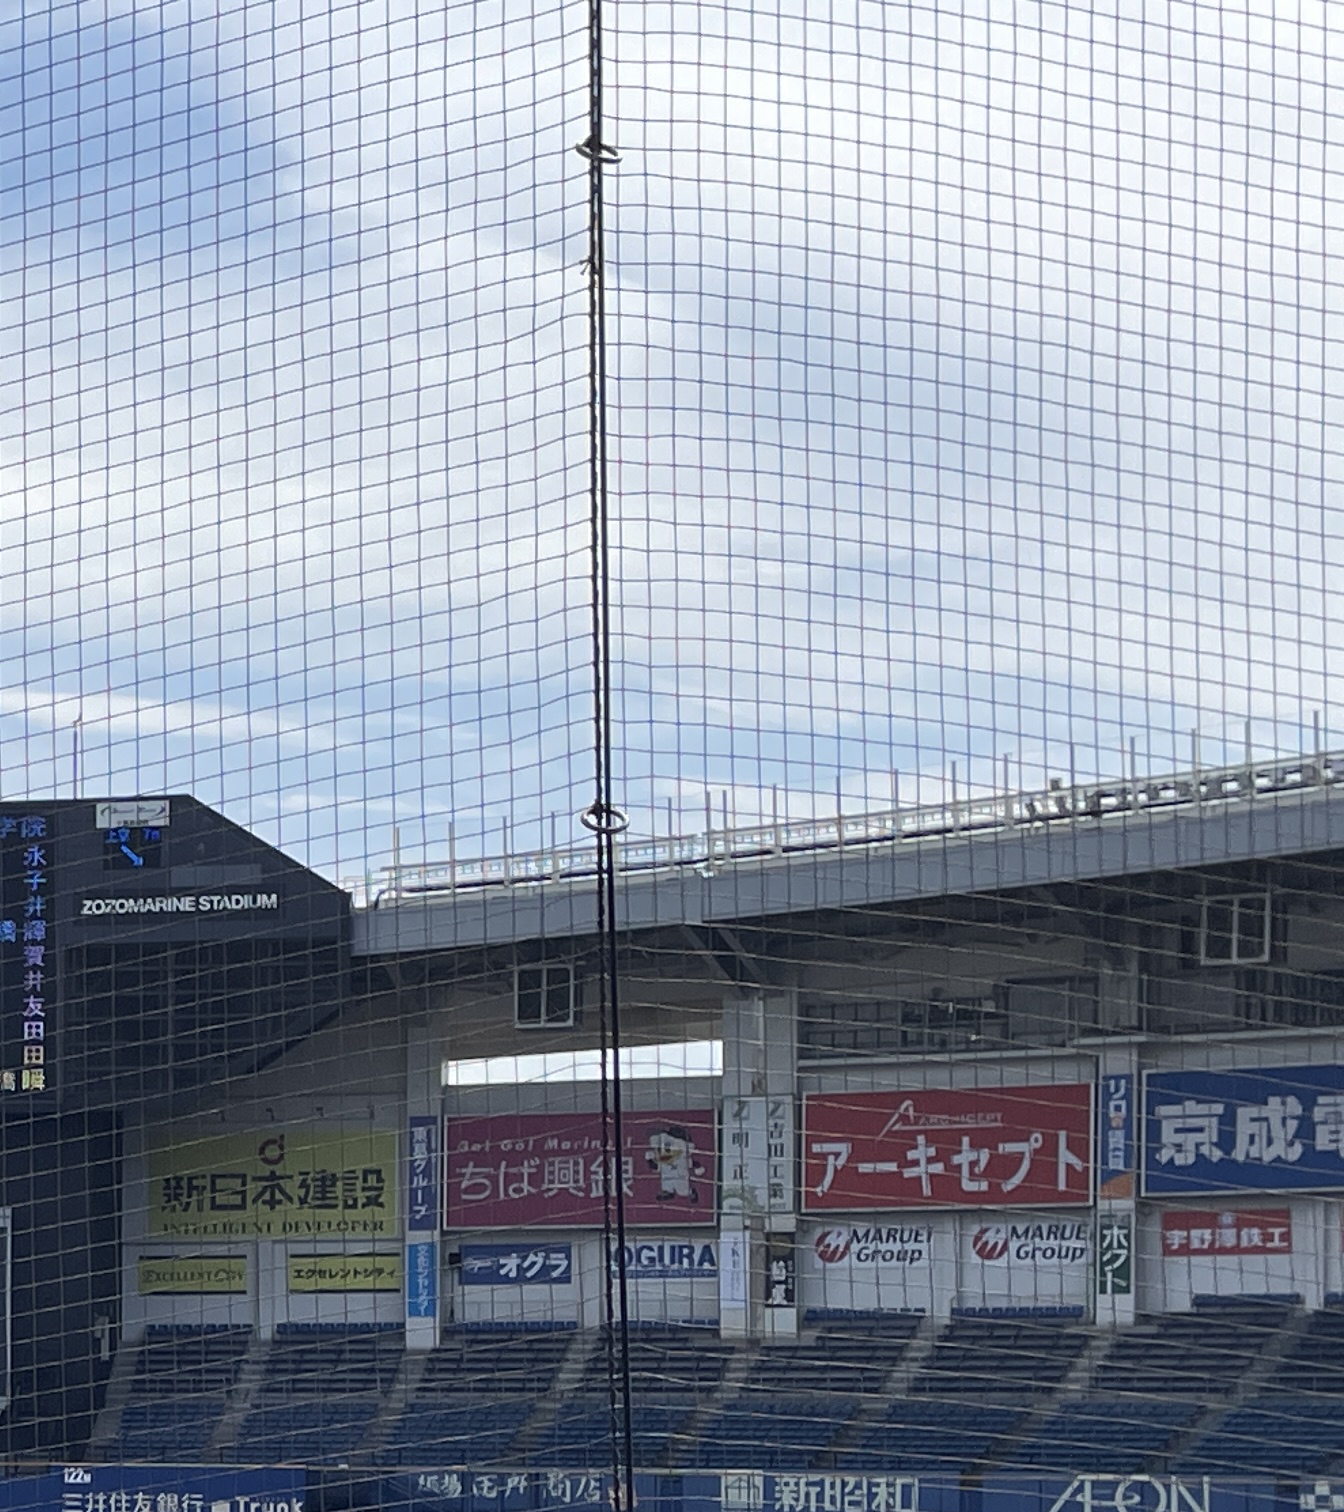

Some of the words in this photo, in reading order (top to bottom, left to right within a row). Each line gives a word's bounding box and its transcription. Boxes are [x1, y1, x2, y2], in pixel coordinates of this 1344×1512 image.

[81, 895, 196, 915] ZOZOMARINE
[199, 893, 278, 912] STADIUM
[812, 1130, 1083, 1197] アーキセプト
[162, 1168, 386, 1213] 新日本建設
[456, 1156, 634, 1200] ちば興銀
[850, 1227, 933, 1244] MARUEI
[499, 1252, 569, 1278] オグラ
[612, 1244, 717, 1268] OGURA
[855, 1246, 924, 1265] Group
[1014, 1243, 1086, 1263] Group
[1102, 1225, 1128, 1294] ホクト
[293, 1267, 397, 1281] エクセレントシティ
